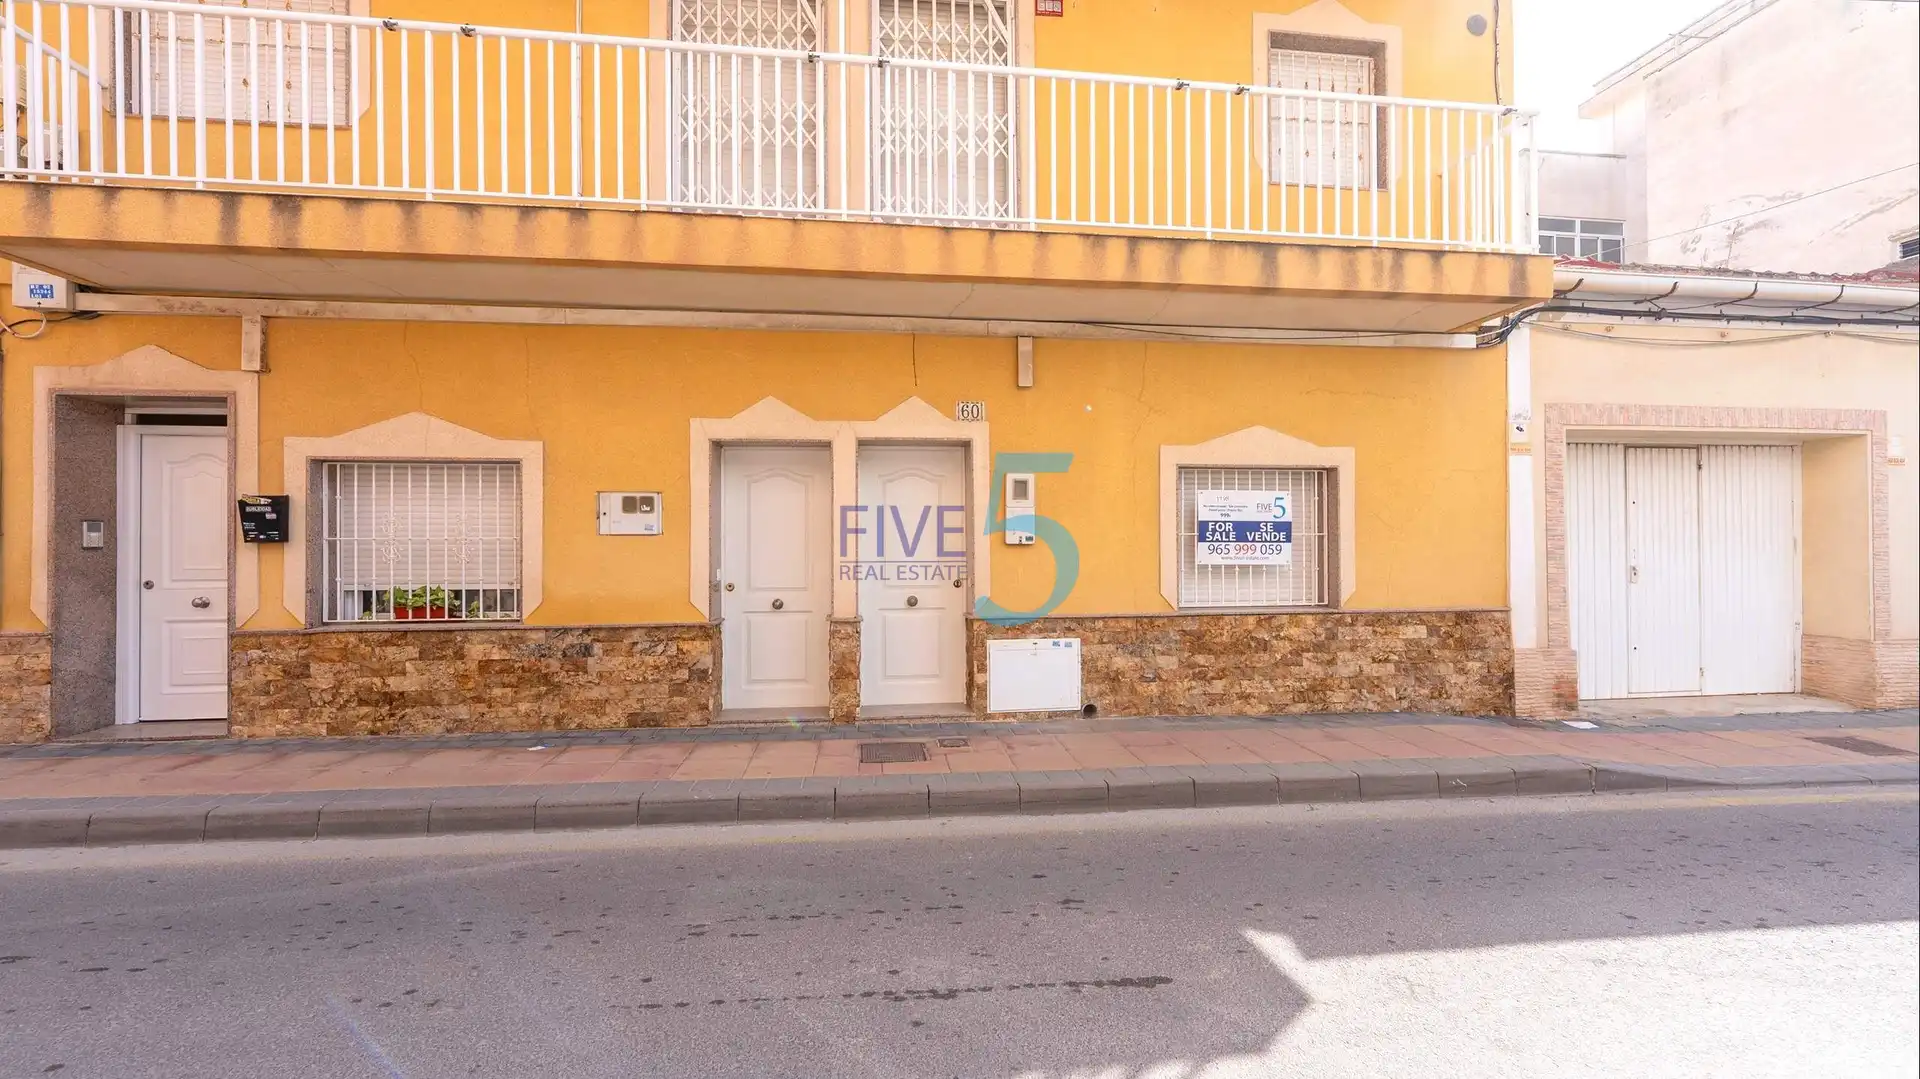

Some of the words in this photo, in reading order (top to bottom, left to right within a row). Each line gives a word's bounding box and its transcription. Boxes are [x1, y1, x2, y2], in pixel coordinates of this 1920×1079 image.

[961, 403, 980, 419] 60
[1256, 502, 1272, 511] FIVE
[1273, 497, 1286, 519] 5
[1208, 522, 1233, 532] FOR
[1259, 522, 1274, 532] SE
[1205, 531, 1237, 541] SALE
[1246, 532, 1287, 542] VENDE
[1207, 543, 1231, 555] 965
[1234, 543, 1257, 555] 999
[1260, 543, 1283, 555] 059
